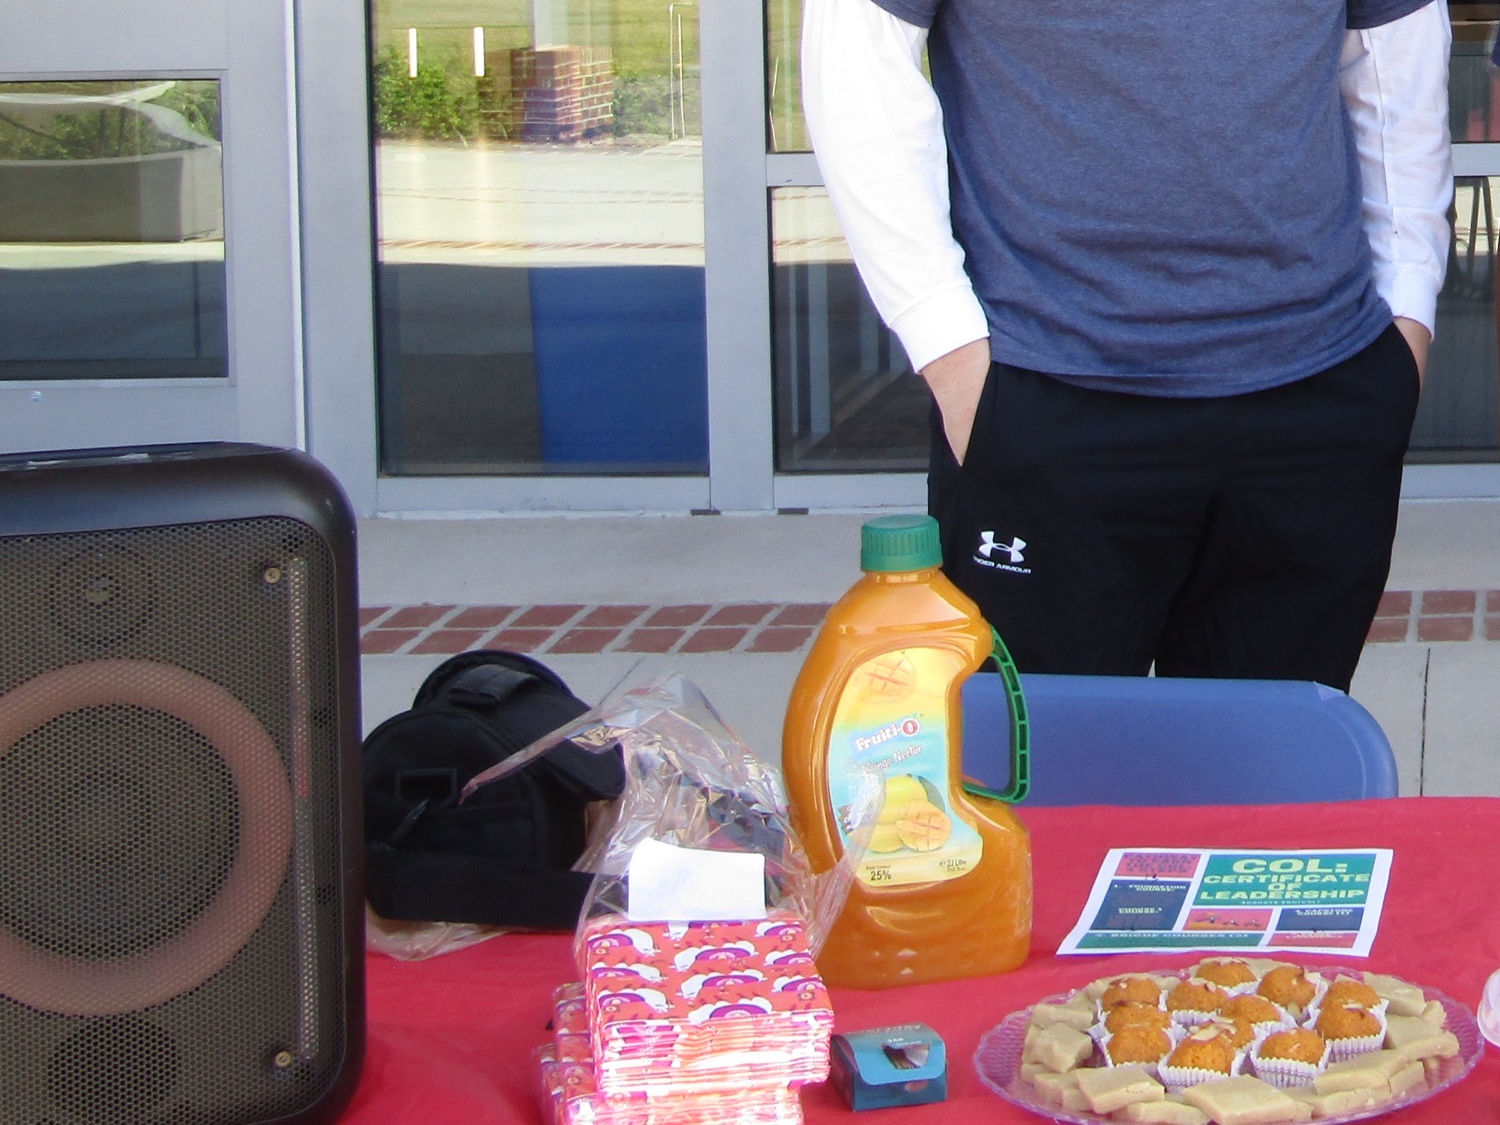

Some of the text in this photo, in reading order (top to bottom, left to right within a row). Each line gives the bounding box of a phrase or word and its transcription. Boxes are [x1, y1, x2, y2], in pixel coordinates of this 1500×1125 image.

[995, 563, 1032, 574] ARMOUR
[865, 745, 923, 772] ango Nectar
[1232, 858, 1348, 874] COL:
[870, 869, 892, 881] 25%
[1203, 873, 1370, 884] CERTIFICATE
[1267, 882, 1302, 891] OF
[1200, 889, 1365, 900] LEADERSHIP
